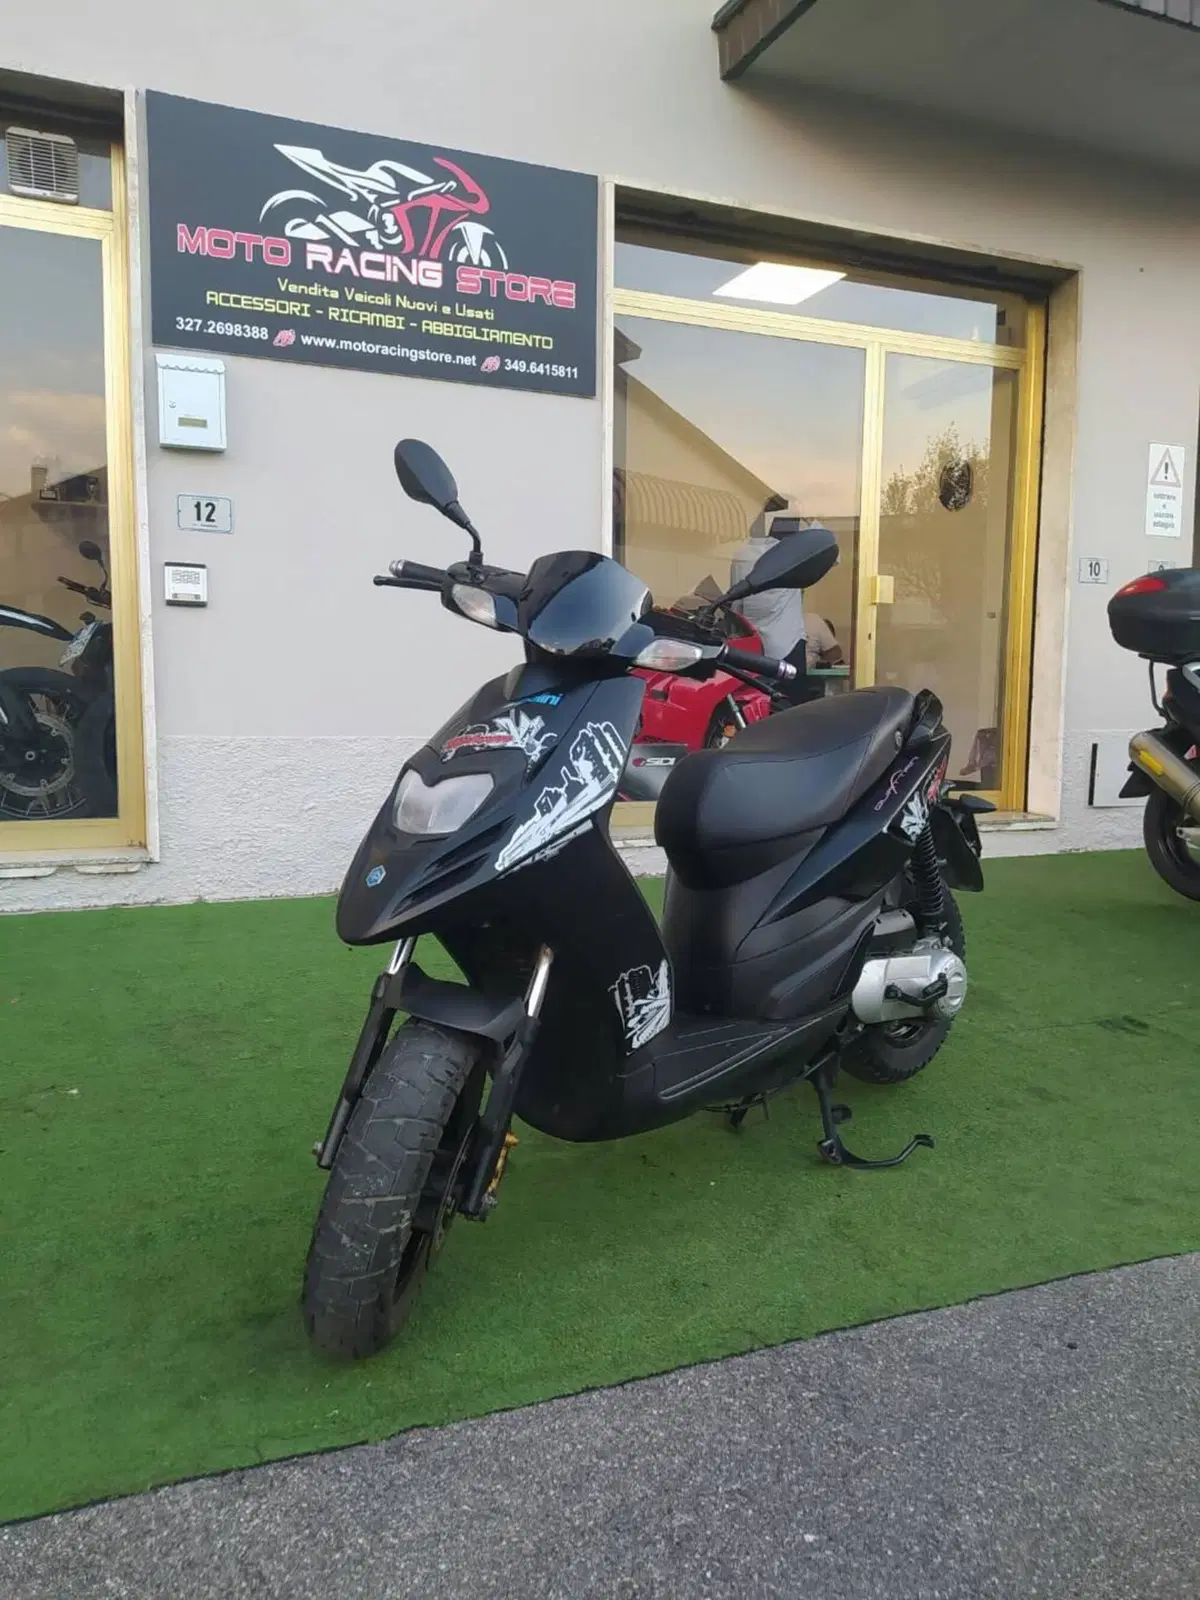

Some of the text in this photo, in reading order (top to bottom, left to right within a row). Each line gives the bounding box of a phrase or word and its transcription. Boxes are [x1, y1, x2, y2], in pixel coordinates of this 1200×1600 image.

[177, 223, 576, 309] MOTO RACING STORE
[206, 291, 311, 318] ACCESSORI
[328, 306, 405, 330] RICAMBI
[422, 319, 553, 350] ABBIGLIAMENTO
[277, 277, 494, 321] Vendita Veicoli Nuovi e Usati
[175, 316, 579, 379] 327.2698388 www.motoracingstore.net 349.6415811
[194, 501, 216, 522] 12
[1089, 561, 1101, 577] 10
